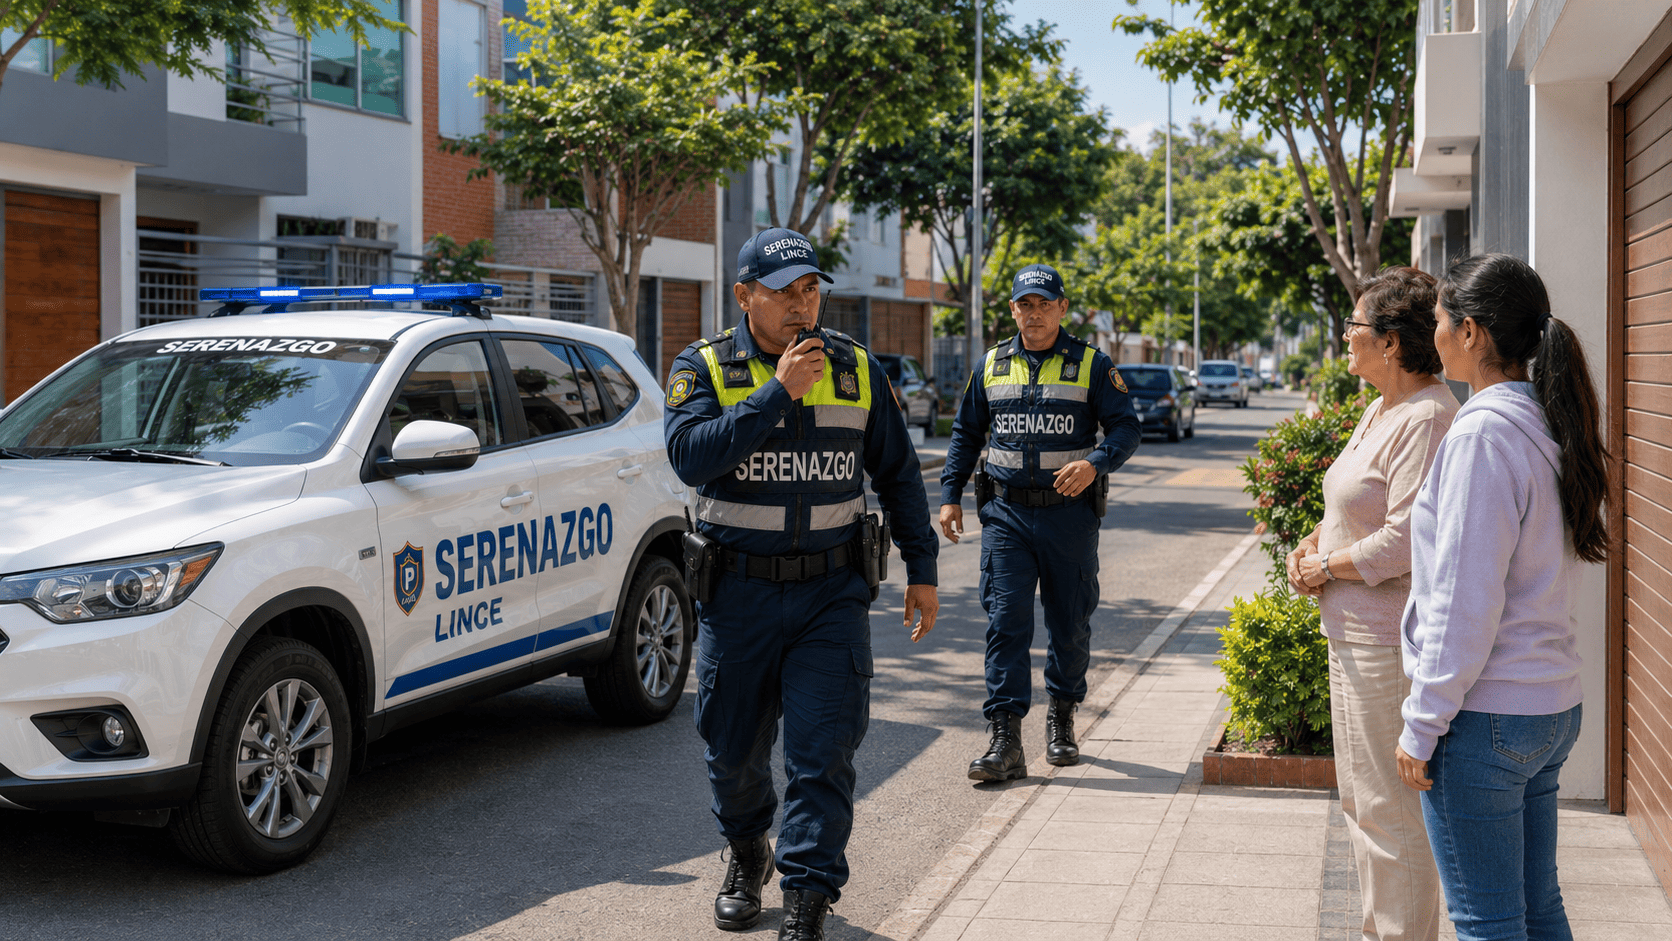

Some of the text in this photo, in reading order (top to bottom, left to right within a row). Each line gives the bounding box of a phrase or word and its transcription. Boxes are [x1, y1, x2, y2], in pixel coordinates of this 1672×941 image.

[780, 249, 808, 260] LINCE
[156, 339, 337, 354] SERENAZGO
[995, 413, 1074, 434] SERENAZGO
[735, 451, 855, 481] SERENAZGO
[435, 502, 613, 600] SERENAZGO
[405, 567, 415, 590] P
[435, 597, 503, 643] LINCE
